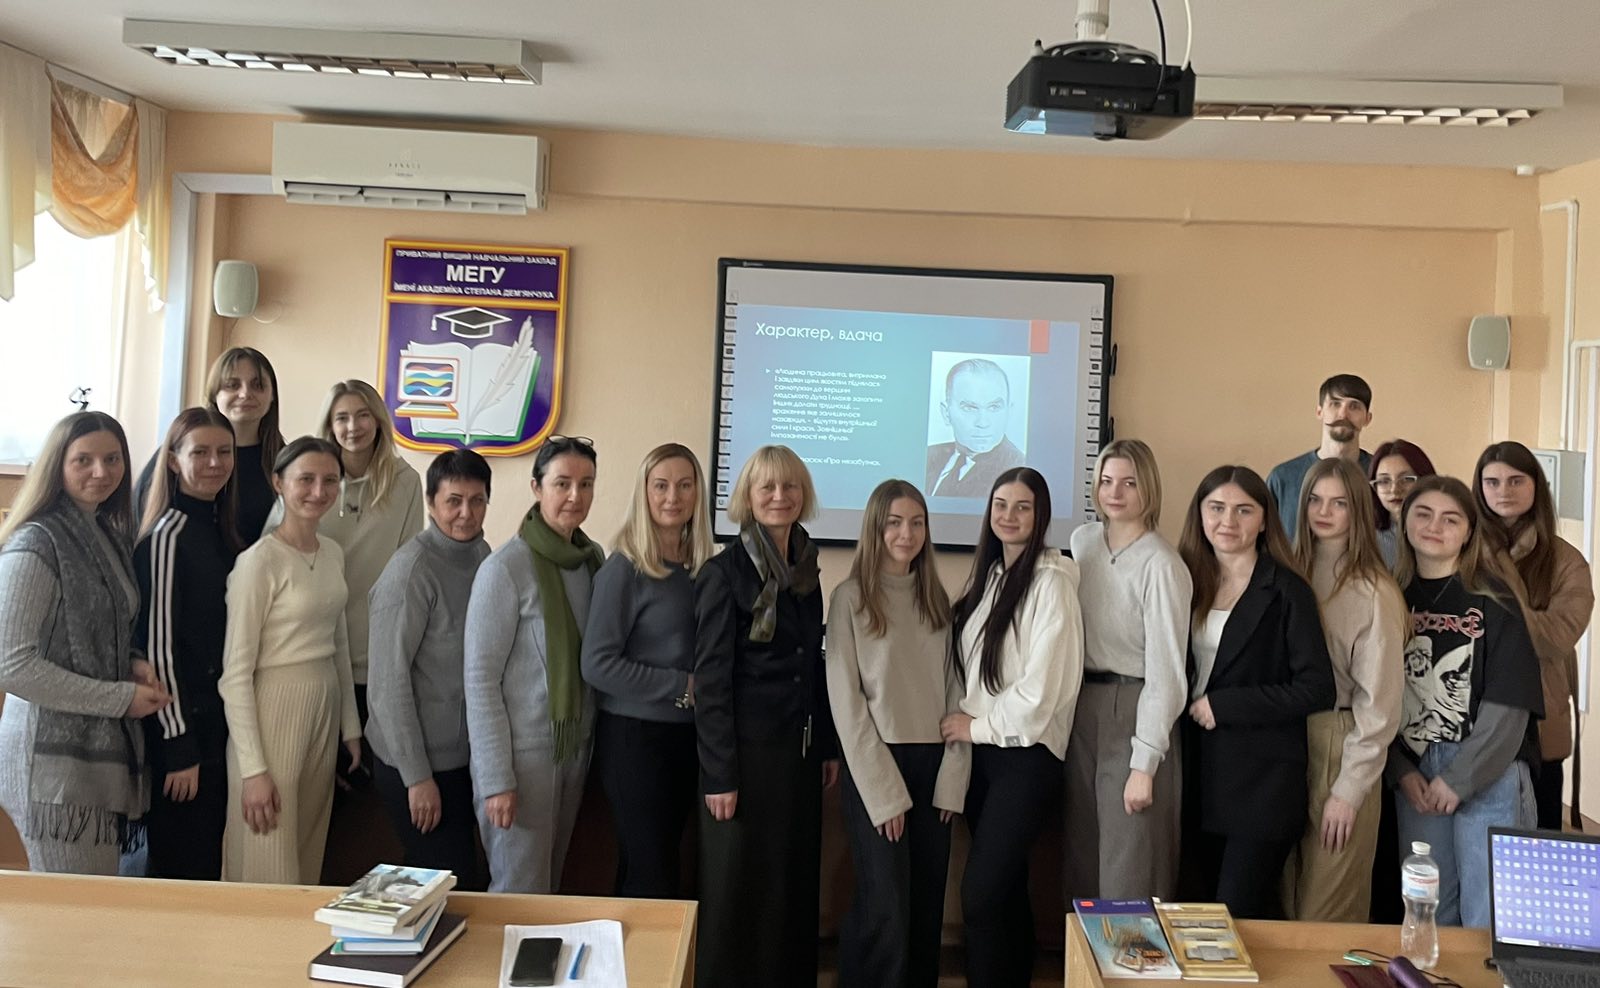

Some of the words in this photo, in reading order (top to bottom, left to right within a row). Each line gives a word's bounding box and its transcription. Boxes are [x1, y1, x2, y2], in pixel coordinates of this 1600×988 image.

[396, 249, 441, 259] ПРИВАТНИЙ
[473, 253, 525, 263] НАВЧАЛЬНИЙ
[526, 256, 557, 266] ЗАКЛАД
[446, 264, 505, 284] МЕГУ
[463, 287, 502, 297] СТЕПАНА
[755, 322, 834, 341] Характер,
[839, 329, 883, 342] вдача
